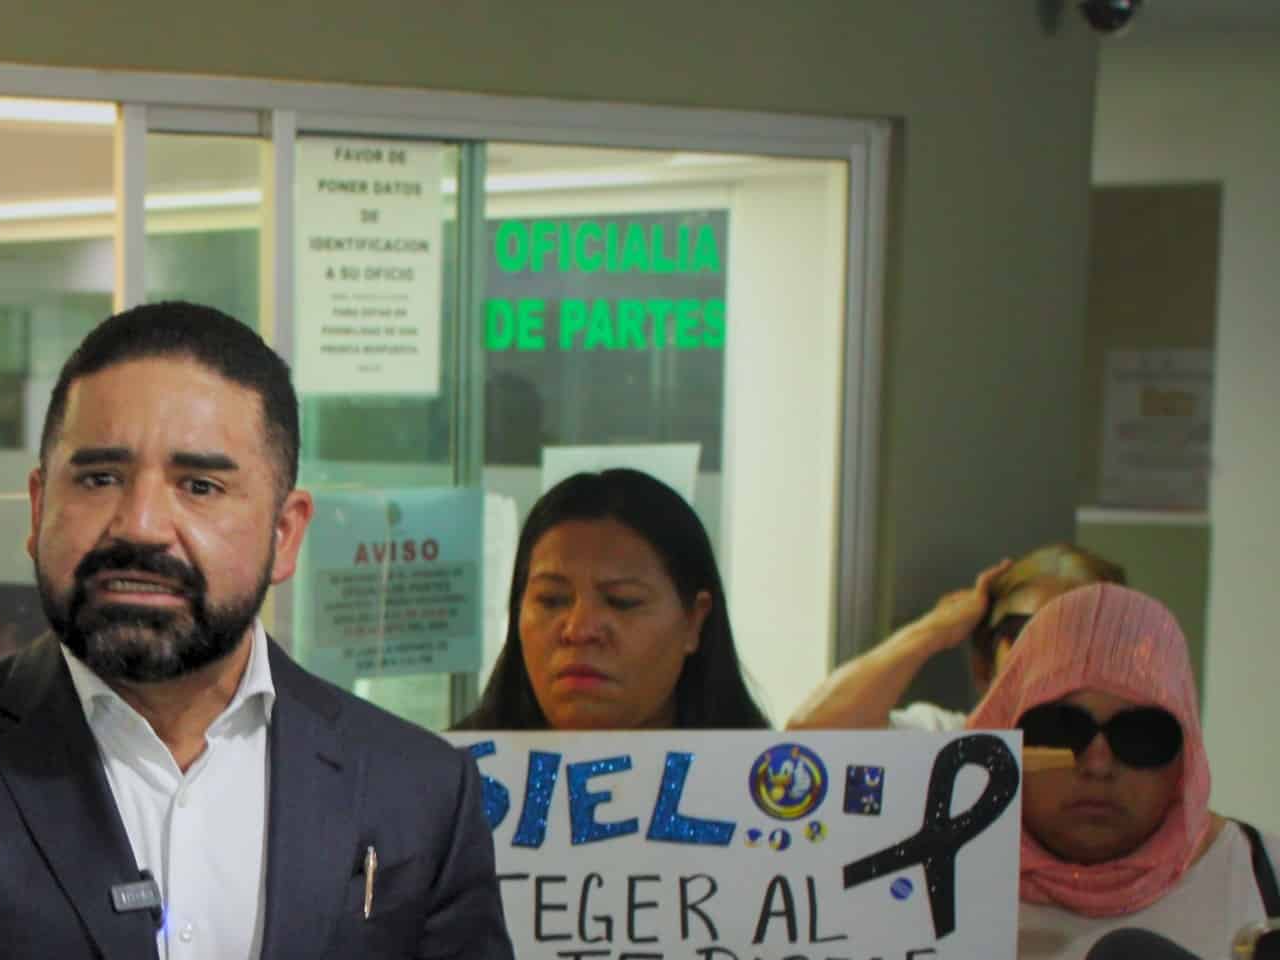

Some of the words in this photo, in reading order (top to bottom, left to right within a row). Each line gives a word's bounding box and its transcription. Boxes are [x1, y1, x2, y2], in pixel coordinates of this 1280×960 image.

[495, 218, 720, 275] OFICIALIA
[486, 297, 546, 351] DE
[558, 297, 725, 352] PARTES
[353, 537, 440, 566] AVISO
[752, 874, 849, 945] AL
